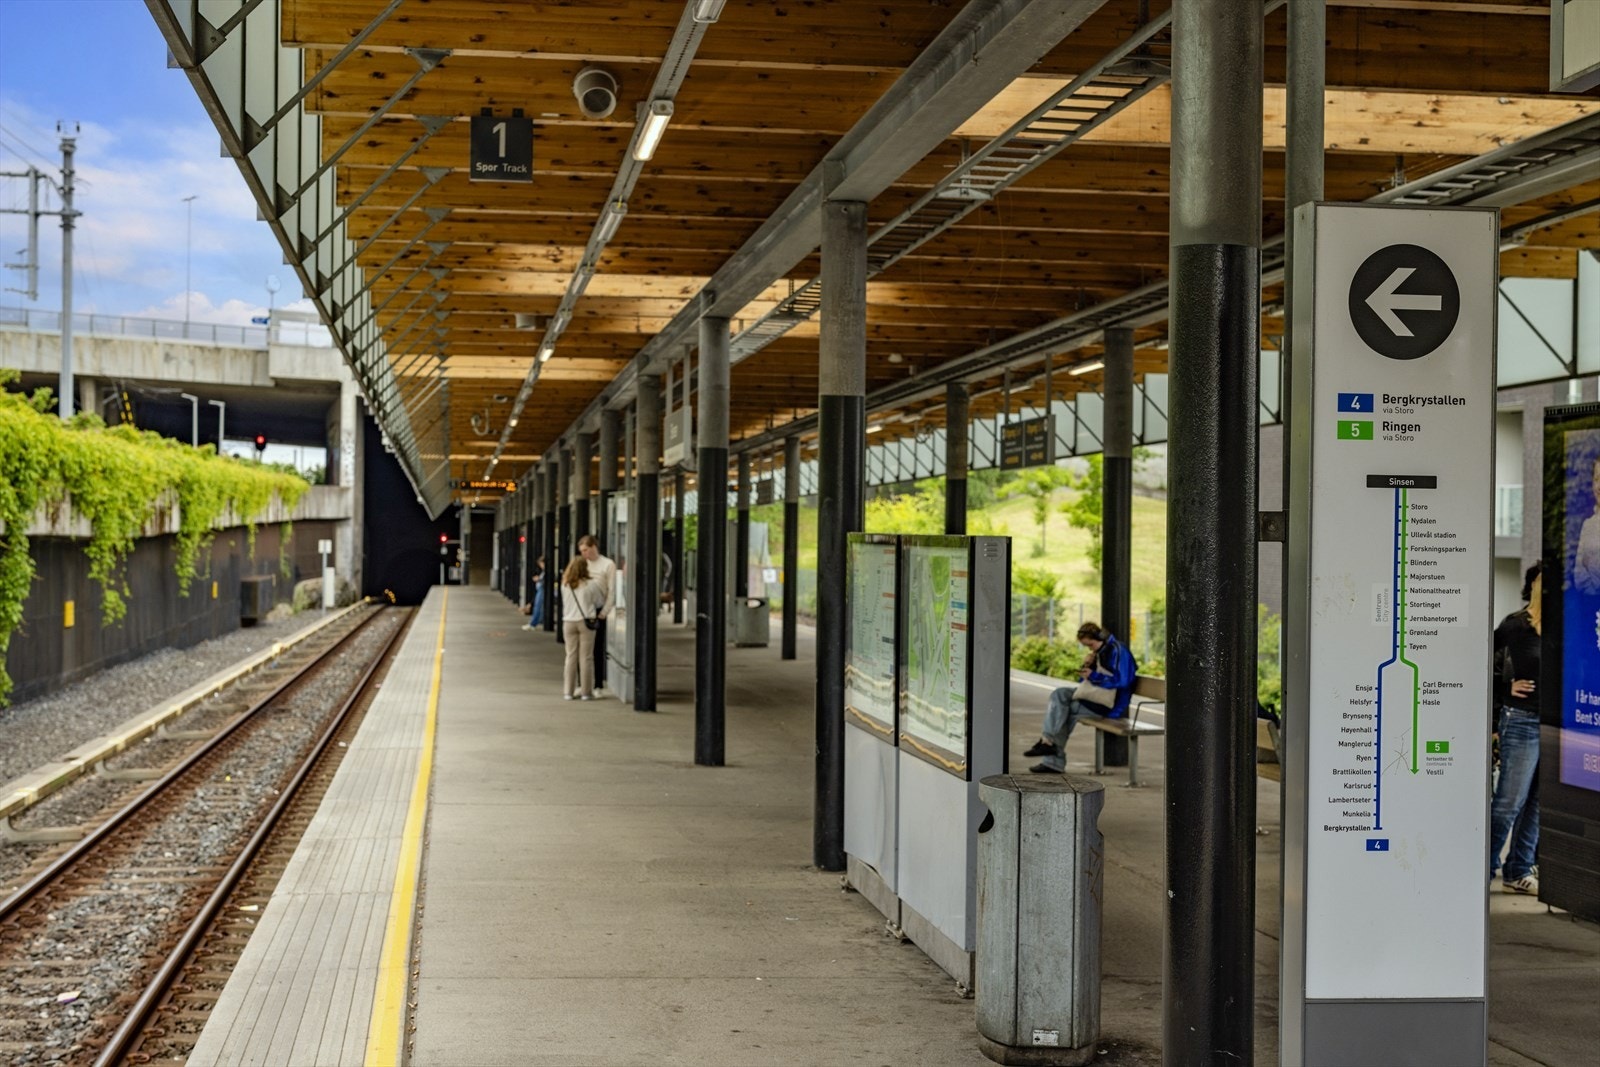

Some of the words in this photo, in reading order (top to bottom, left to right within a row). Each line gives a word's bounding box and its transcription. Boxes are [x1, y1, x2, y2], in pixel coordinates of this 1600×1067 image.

[492, 122, 506, 158] 1
[476, 163, 498, 173] Spor
[502, 163, 527, 173] Track
[1351, 396, 1360, 409] 4
[1382, 394, 1466, 406] Bergkrystallen
[1351, 423, 1360, 437] 5
[1382, 421, 1421, 434] Ringen
[1389, 478, 1415, 486] Sinsen
[1411, 531, 1432, 539] Ullevål
[1410, 601, 1441, 609] Stortinget
[1410, 615, 1457, 623] Jernbanetorget
[1343, 713, 1372, 721] Brynseng
[1575, 709, 1593, 725] Bent
